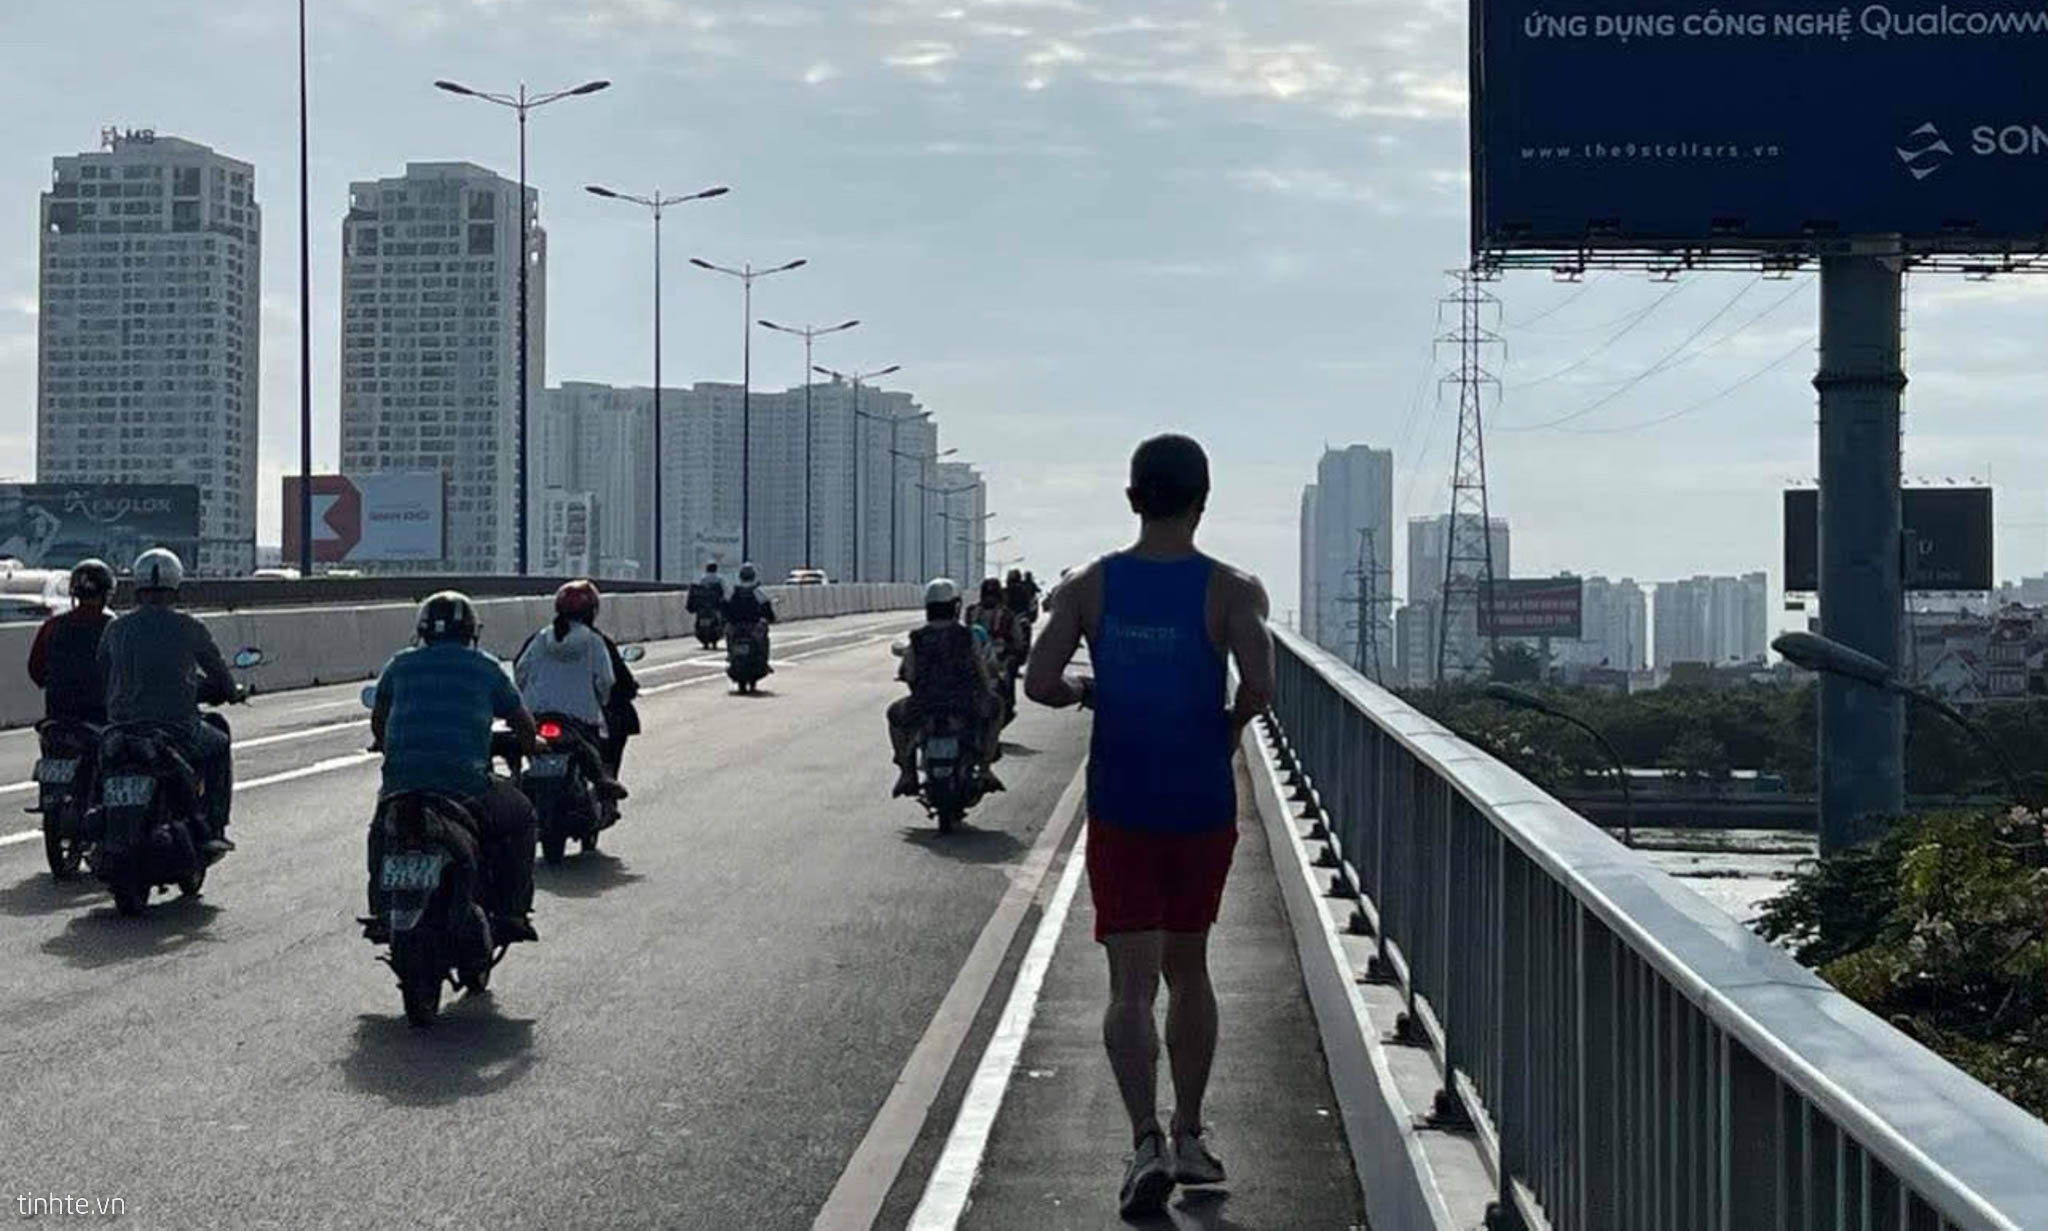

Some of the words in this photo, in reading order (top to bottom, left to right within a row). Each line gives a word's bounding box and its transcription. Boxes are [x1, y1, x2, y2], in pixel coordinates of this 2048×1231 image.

[1523, 10, 1588, 38] ỨNG
[1595, 13, 1676, 43] DỤNG
[1682, 8, 1767, 37] CÔNG
[1773, 6, 1852, 42] NGHỆ
